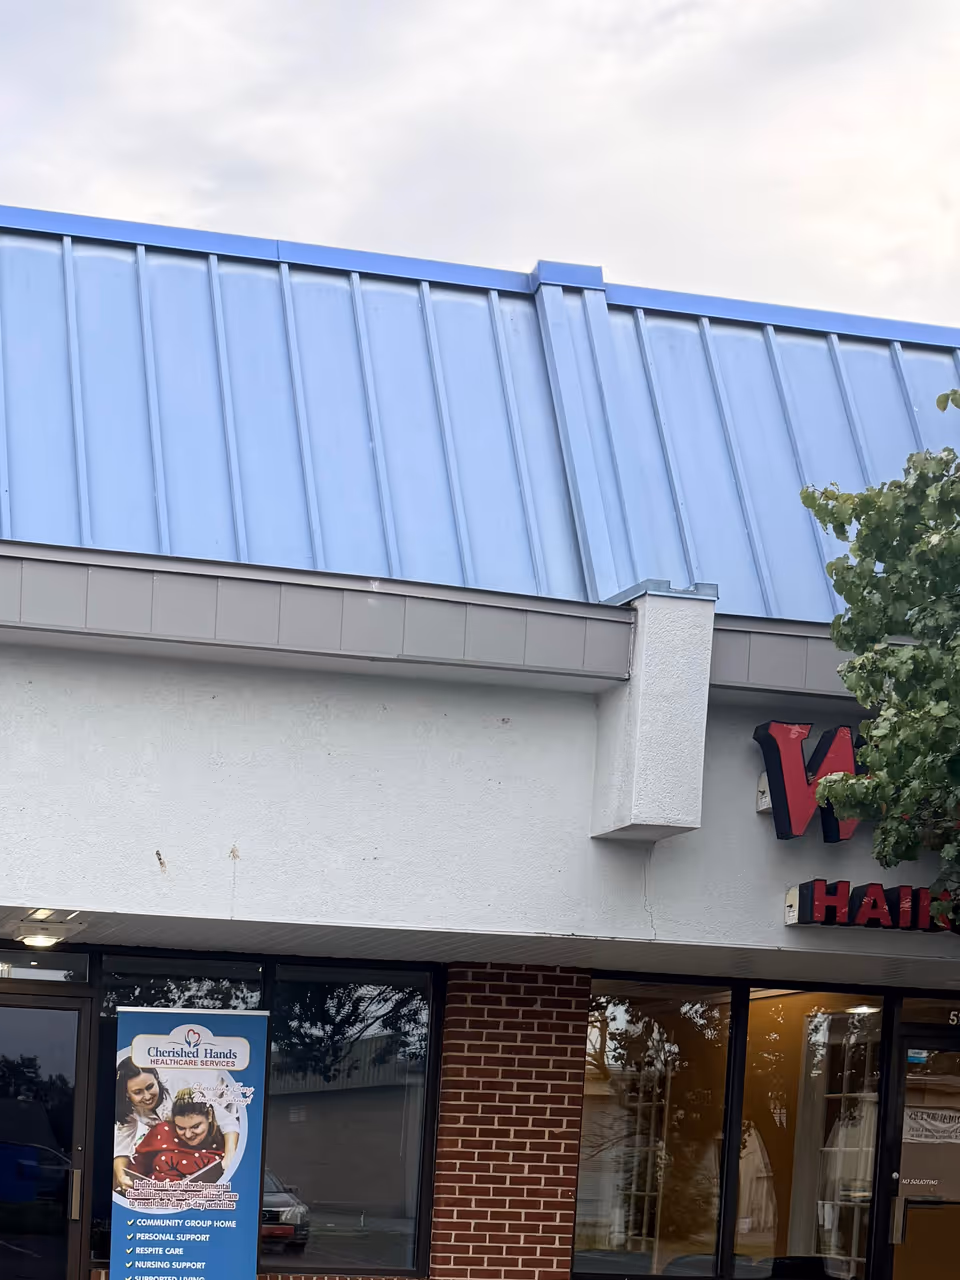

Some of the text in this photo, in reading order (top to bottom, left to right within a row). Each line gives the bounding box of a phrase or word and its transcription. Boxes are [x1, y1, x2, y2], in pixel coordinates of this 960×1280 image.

[948, 1010, 960, 1025] 5
[147, 1046, 238, 1060] Cherished Hands
[150, 1058, 236, 1068] HEALTHCARE SERVICES
[134, 1180, 231, 1192] Individual with developmental
[126, 1189, 161, 1199] disabilities
[162, 1192, 185, 1201] require
[186, 1191, 224, 1202] specialized
[128, 1200, 136, 1208] to
[153, 1200, 170, 1208] their
[207, 1202, 236, 1210] activities
[136, 1218, 237, 1228] COMMUNITY GROUP HOME
[136, 1233, 210, 1242] PERSONAL SUPPORT
[135, 1247, 164, 1255] RESPITE
[135, 1261, 206, 1270] NURSING SUPPORT
